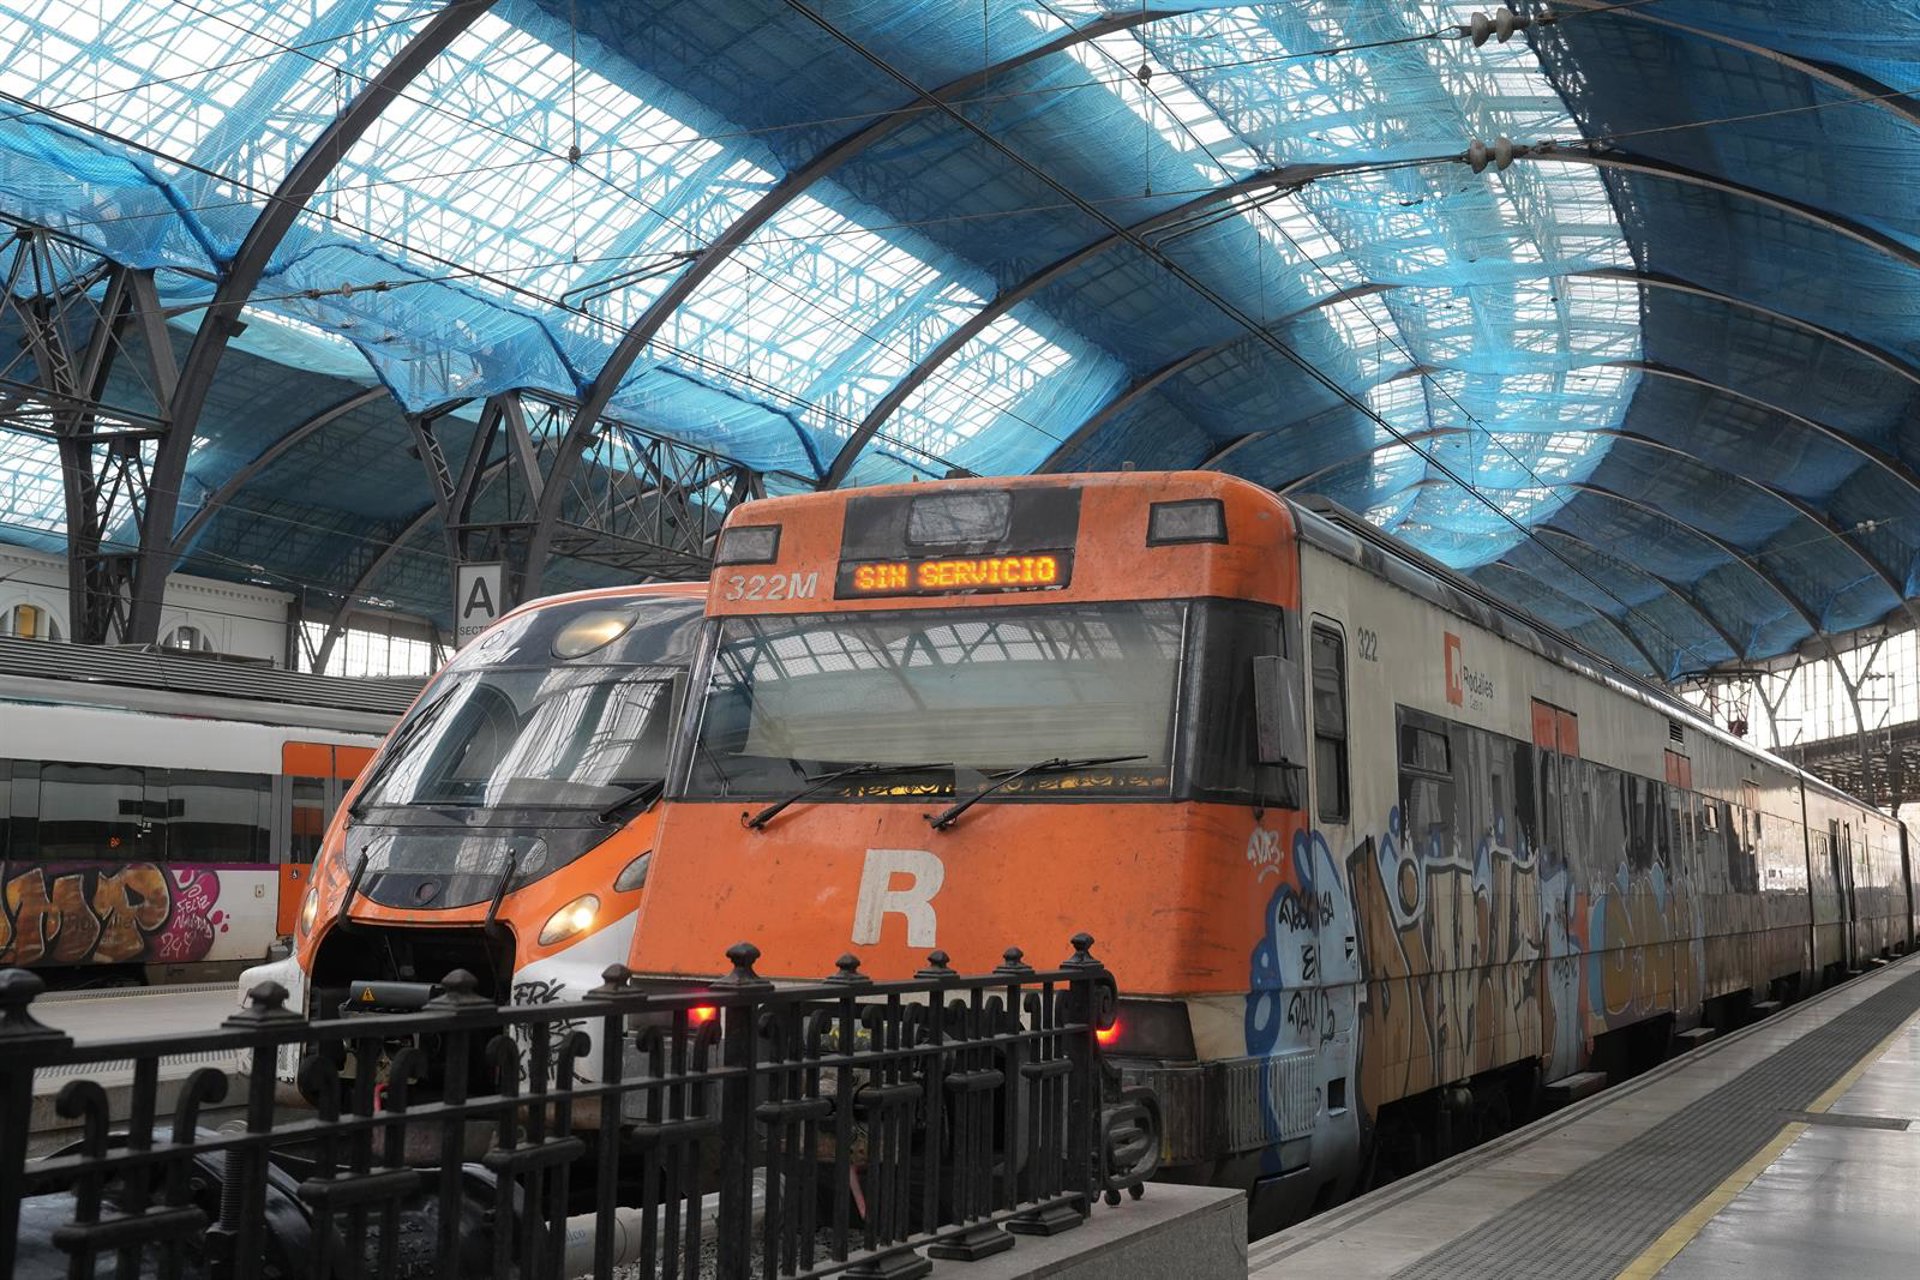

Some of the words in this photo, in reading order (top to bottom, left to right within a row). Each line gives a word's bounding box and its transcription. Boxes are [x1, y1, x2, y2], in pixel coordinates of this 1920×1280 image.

[725, 572, 818, 601] 322M
[855, 564, 908, 590] SIN
[918, 555, 1057, 587] SERVICIO
[463, 576, 495, 619] A
[1357, 626, 1379, 662] 322
[851, 848, 945, 948] R
